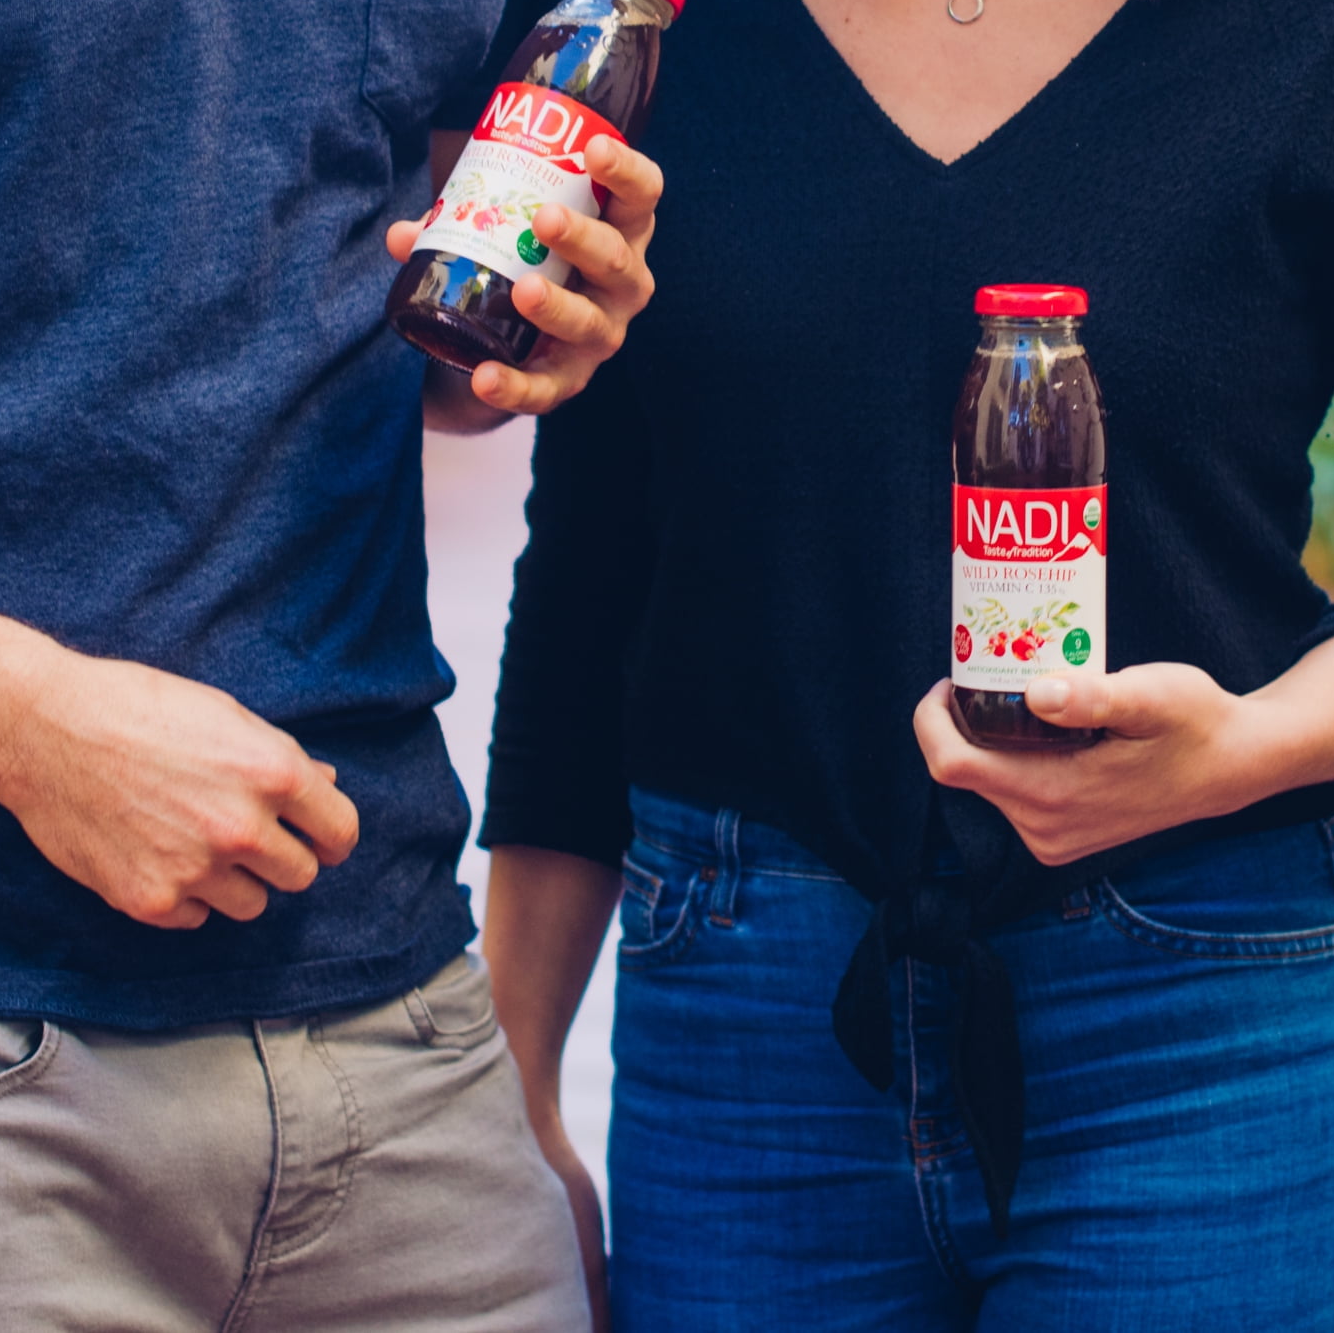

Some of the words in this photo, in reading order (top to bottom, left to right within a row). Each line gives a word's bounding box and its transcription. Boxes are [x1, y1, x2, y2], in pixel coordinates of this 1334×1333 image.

[482, 90, 584, 154] NADI
[497, 148, 564, 186] ROSEHIP
[531, 238, 539, 249] 9
[967, 498, 1069, 546] NADI
[983, 545, 1006, 556] Taste
[1013, 546, 1053, 558] Tradition
[963, 566, 998, 579] WILD
[1004, 567, 1077, 582] ROSEHIP
[969, 581, 1021, 594] VITAMIN
[1025, 583, 1033, 594] C
[1075, 638, 1082, 650] 9
